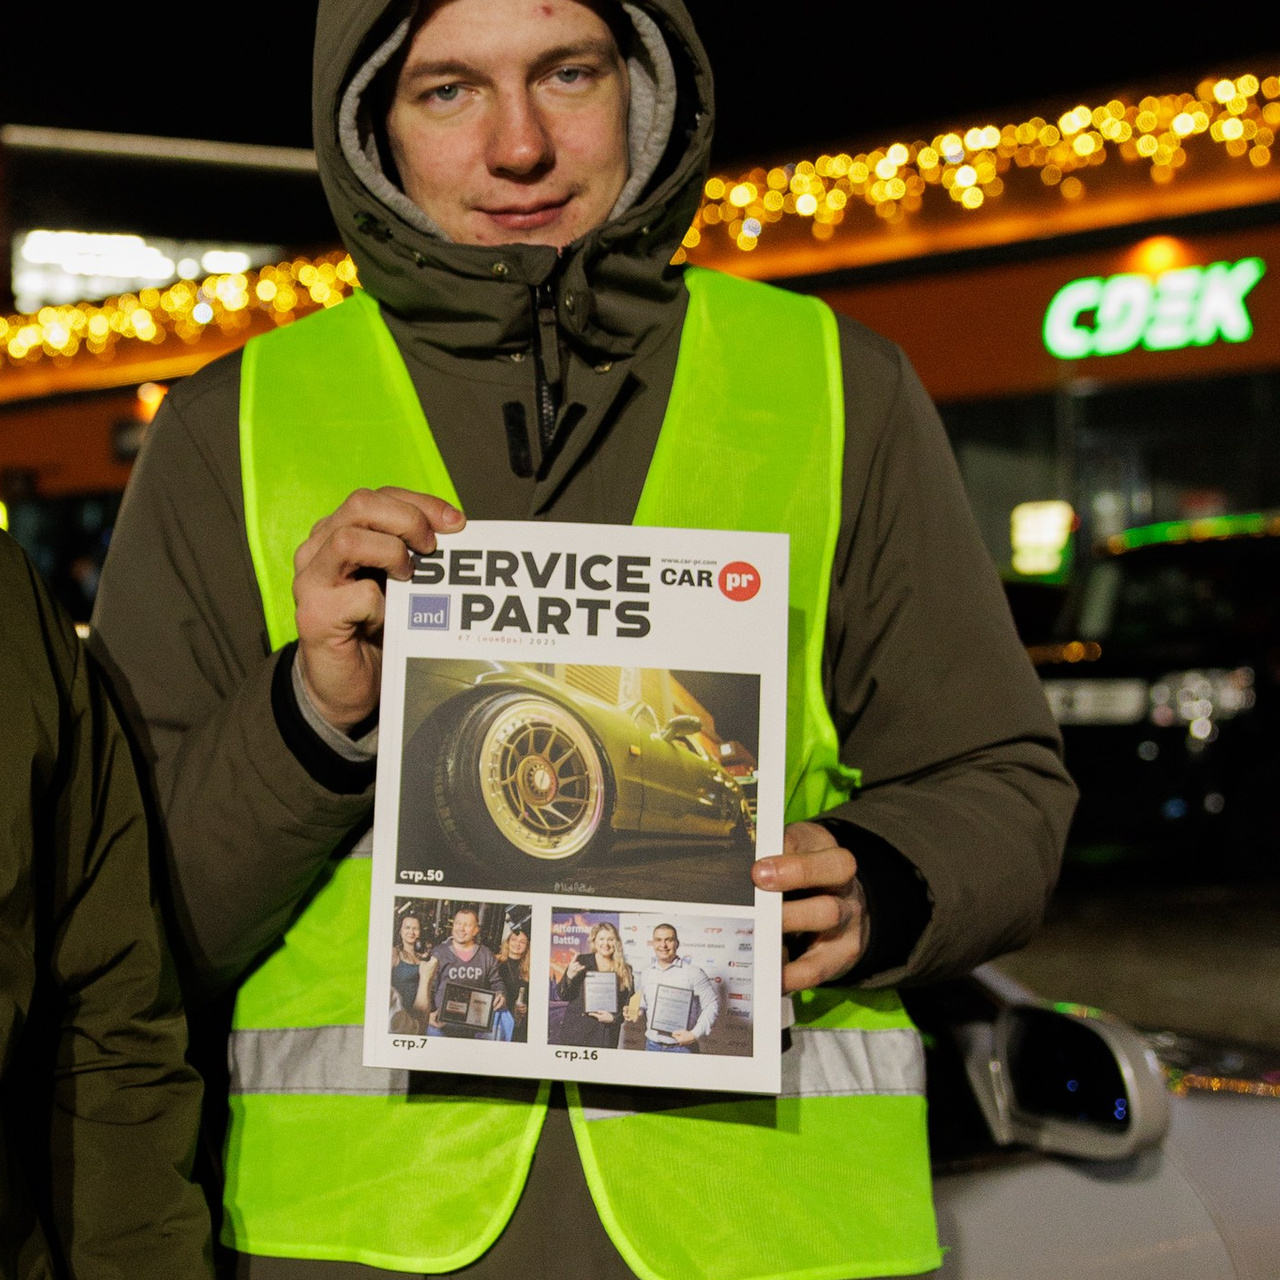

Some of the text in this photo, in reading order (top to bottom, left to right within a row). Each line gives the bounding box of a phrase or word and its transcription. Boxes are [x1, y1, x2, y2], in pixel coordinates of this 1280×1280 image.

[1043, 256, 1267, 361] CDEK
[411, 549, 651, 593] SERVICE
[660, 568, 755, 592] CAR pr
[413, 593, 652, 639] and PARTS
[529, 638, 557, 646] 2025
[399, 869, 445, 883] стр.50
[553, 935, 580, 945] Battle
[448, 966, 483, 980] СССР
[392, 1038, 428, 1051] стр.7
[555, 1049, 598, 1061] стр.16
